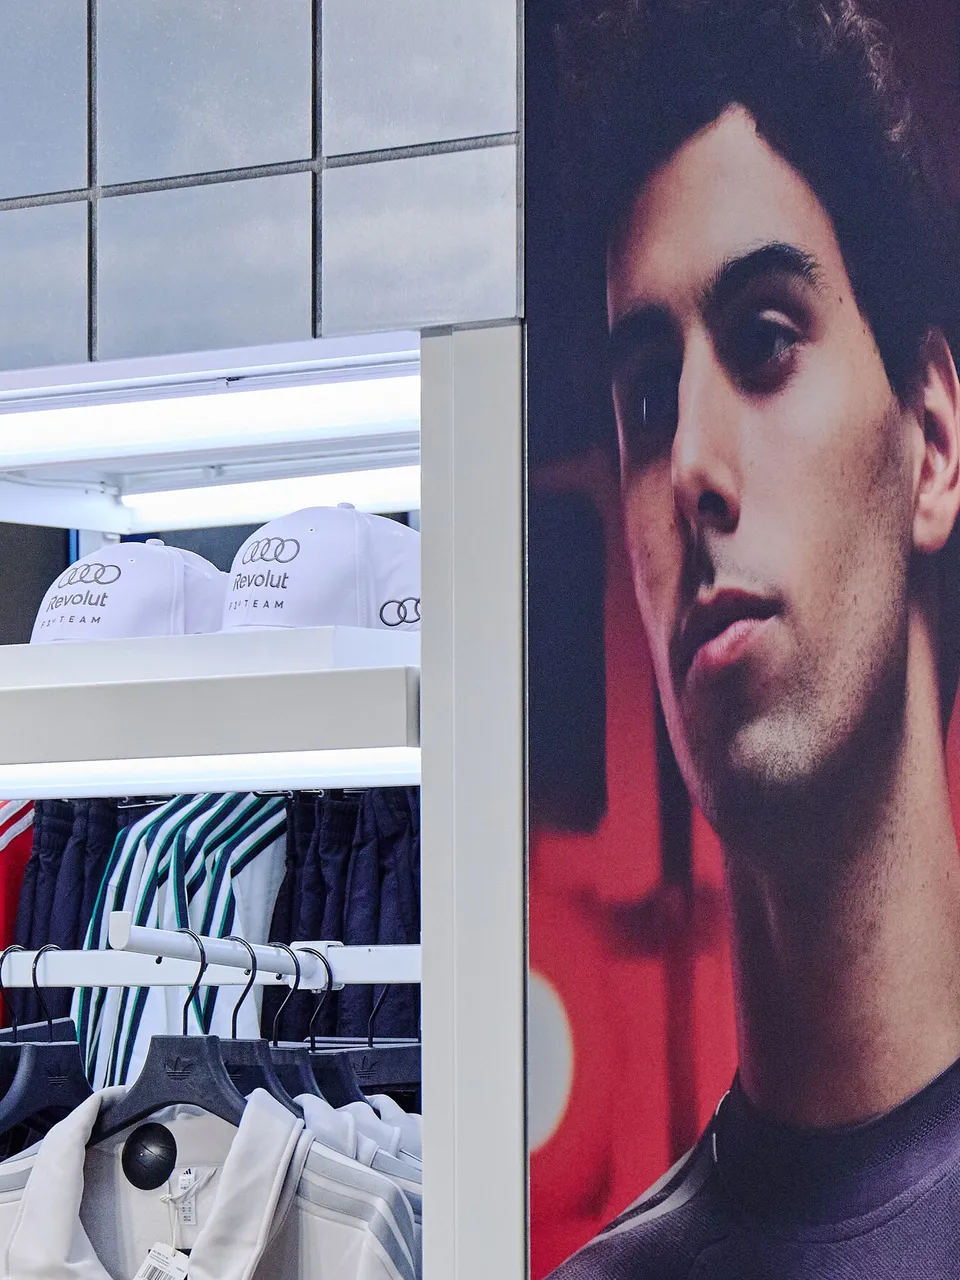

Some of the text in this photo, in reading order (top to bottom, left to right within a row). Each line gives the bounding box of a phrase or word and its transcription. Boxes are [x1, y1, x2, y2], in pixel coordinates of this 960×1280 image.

[233, 570, 289, 591] Revolut
[46, 590, 108, 612] Revolut
[244, 599, 284, 609] TEAM
[59, 615, 101, 625] TEAM
